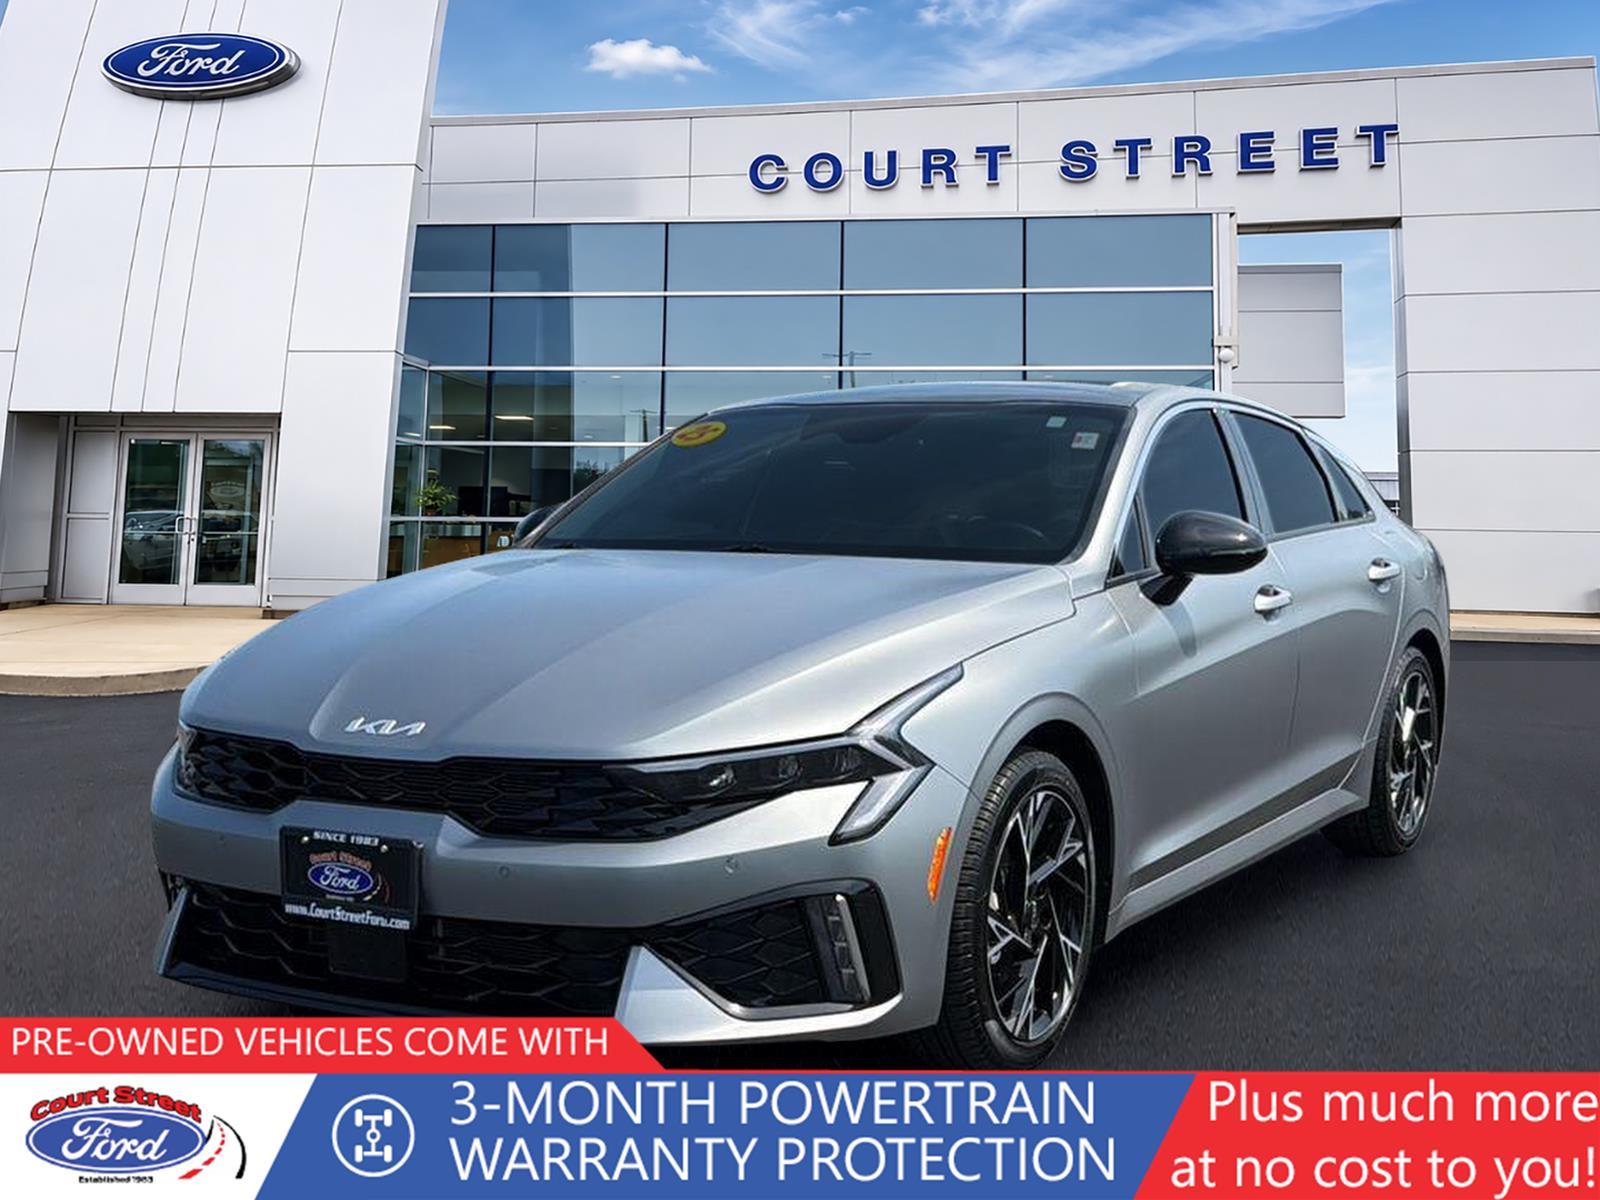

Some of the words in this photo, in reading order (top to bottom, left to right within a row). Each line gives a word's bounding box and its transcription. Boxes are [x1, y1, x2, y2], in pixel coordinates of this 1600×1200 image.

[137, 43, 246, 77] Ford
[748, 144, 1011, 192] COURT
[1059, 122, 1399, 182] STREET
[313, 830, 347, 843] SINCE
[319, 864, 361, 890] Ford
